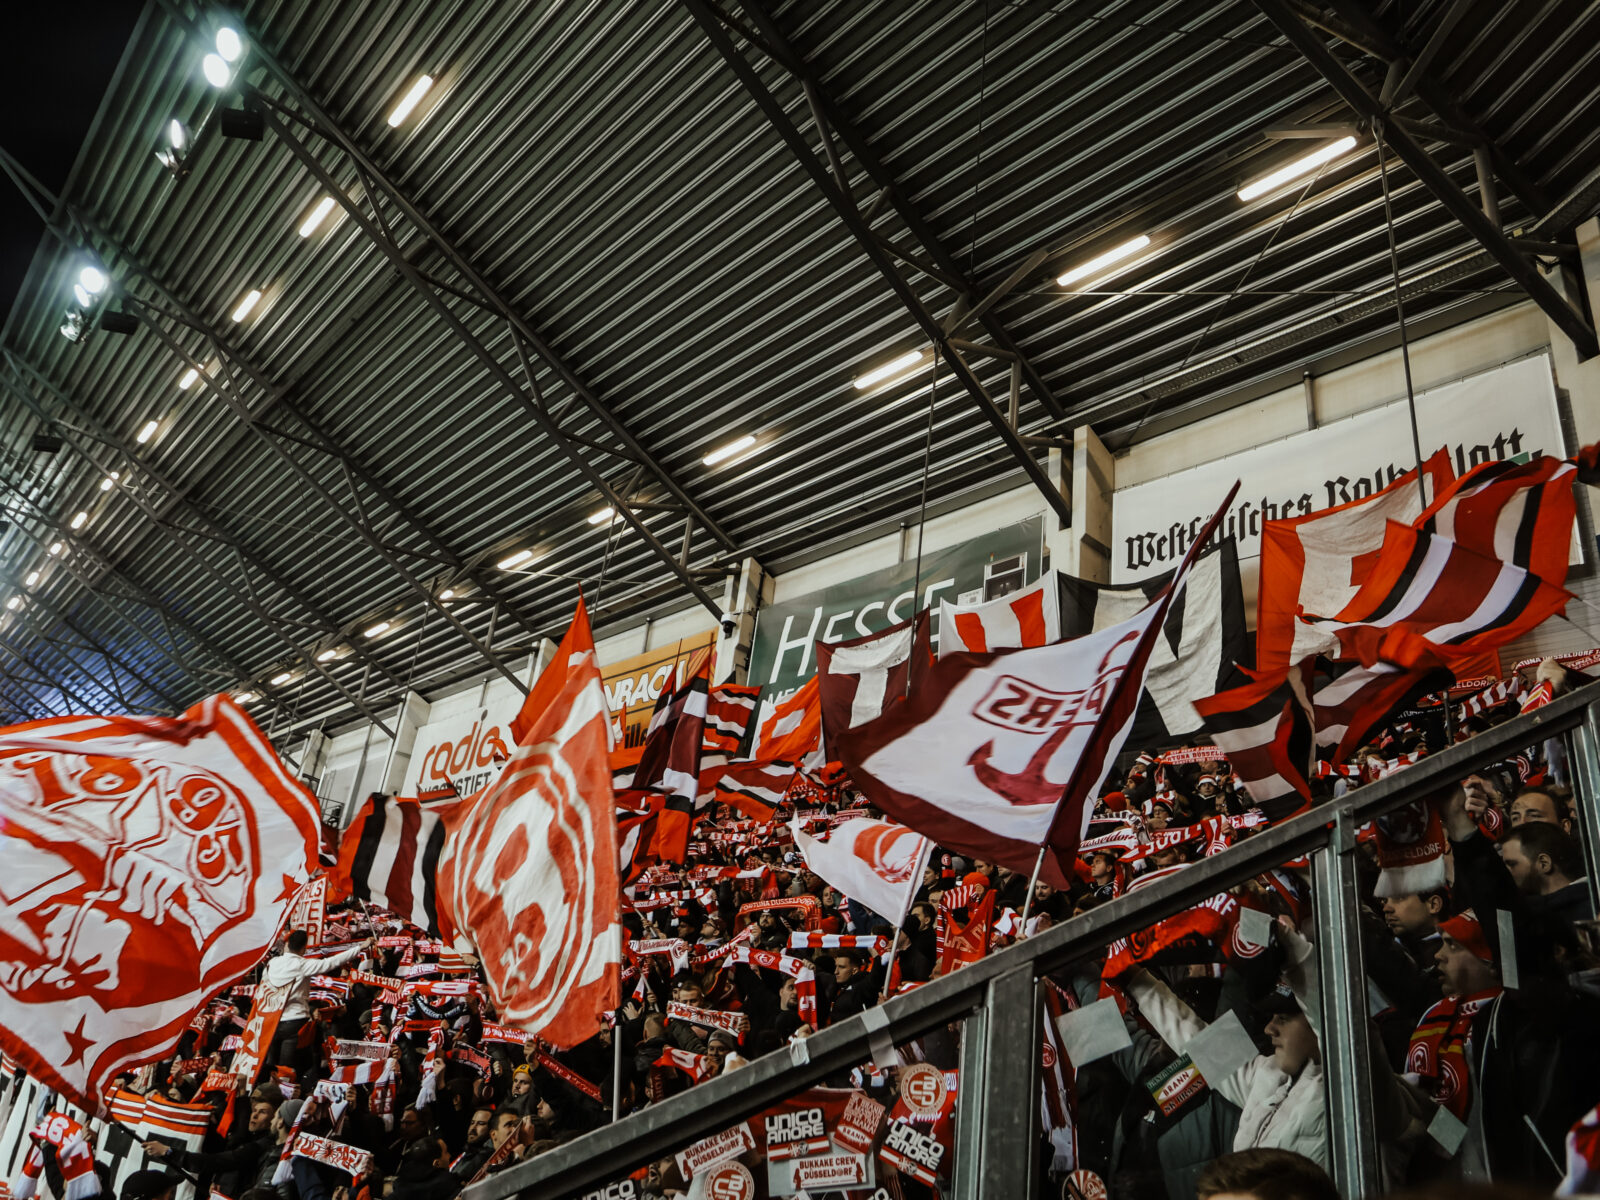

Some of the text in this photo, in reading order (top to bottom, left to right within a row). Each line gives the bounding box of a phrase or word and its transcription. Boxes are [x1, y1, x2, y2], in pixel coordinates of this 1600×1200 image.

[1162, 1071, 1189, 1097] BRANN
[765, 1107, 822, 1132] UNICO
[684, 1125, 742, 1160] BUKKAKE CREW
[767, 1121, 825, 1145] AMORE
[890, 1119, 945, 1159] UNICO
[799, 1155, 857, 1169] BUKKAKE CREW
[885, 1135, 941, 1171] AMORE
